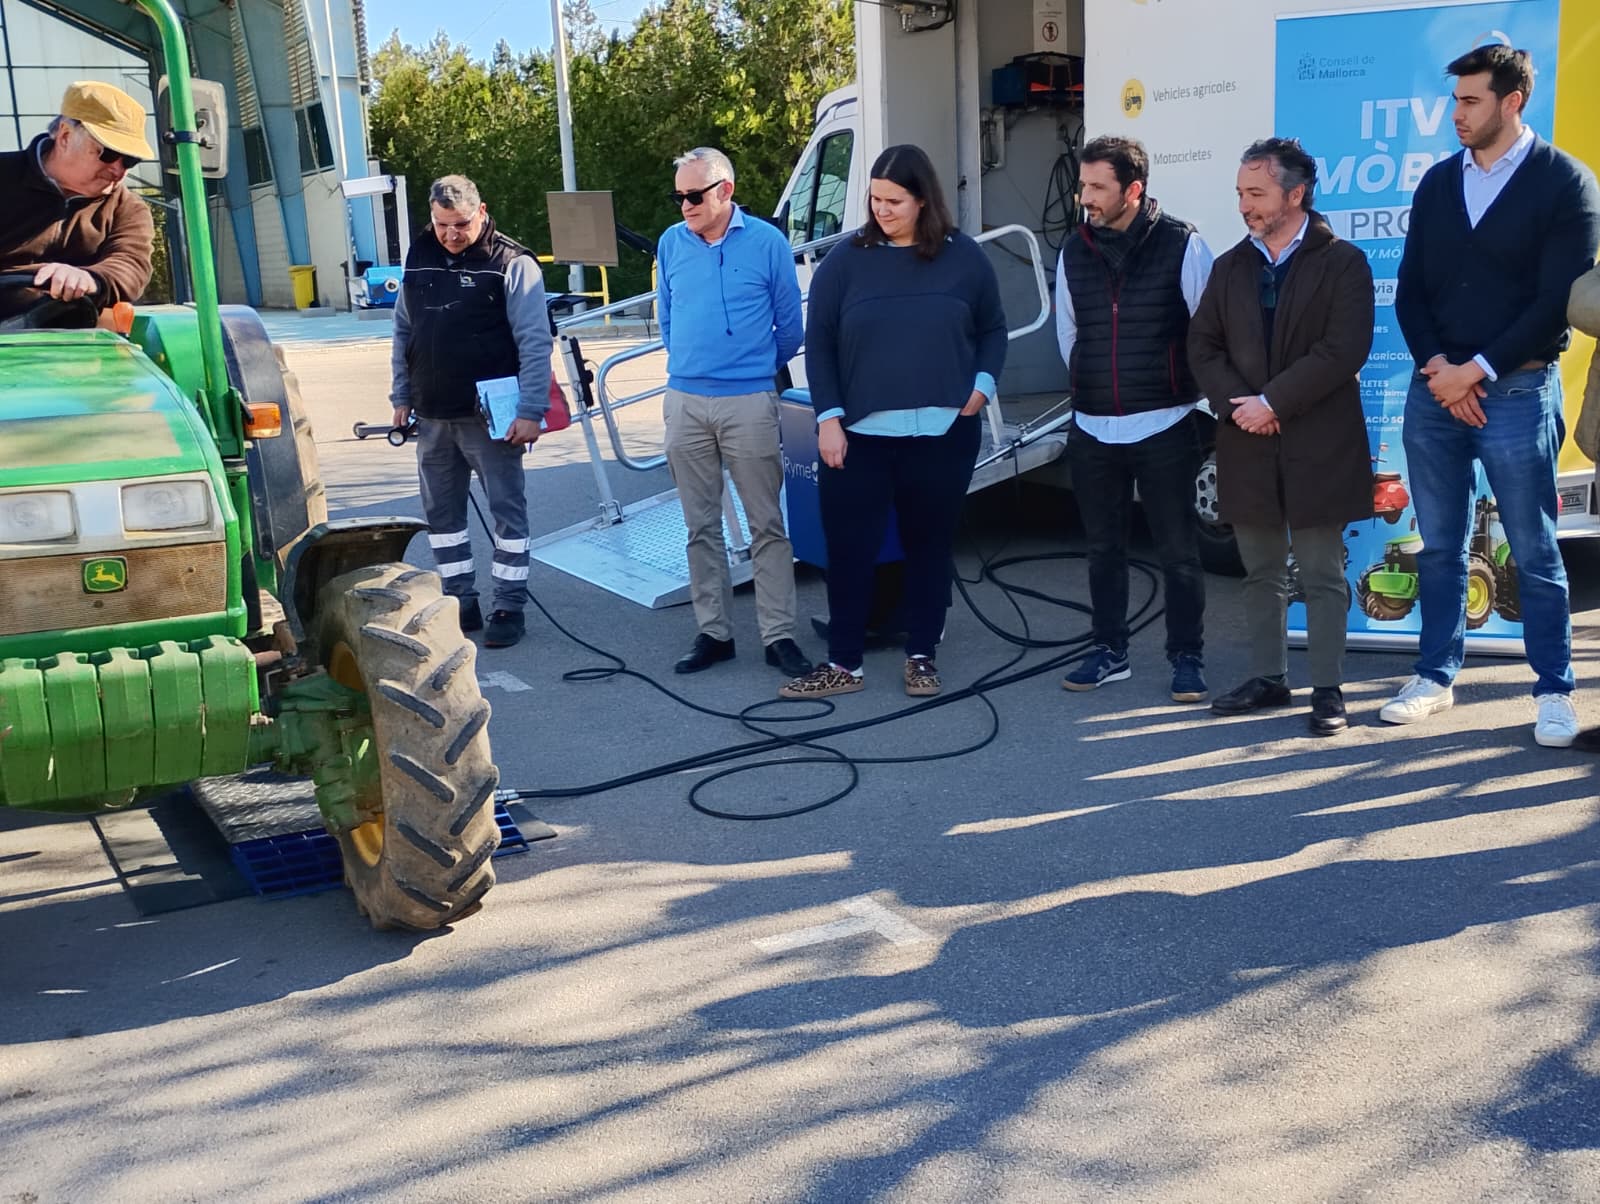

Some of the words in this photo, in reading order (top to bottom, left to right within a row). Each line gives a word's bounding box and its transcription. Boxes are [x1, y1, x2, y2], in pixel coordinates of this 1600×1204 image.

[1319, 55, 1359, 68] Consell
[1361, 55, 1376, 65] de
[1319, 68, 1367, 79] Mallorca
[1152, 86, 1191, 103] Vehicles
[1360, 95, 1450, 140] ITV
[1153, 149, 1213, 166] Motocicletes
[1313, 140, 1452, 196] MÒB
[1367, 350, 1414, 361] AGRÍCOL
[784, 455, 812, 479] Ryme
